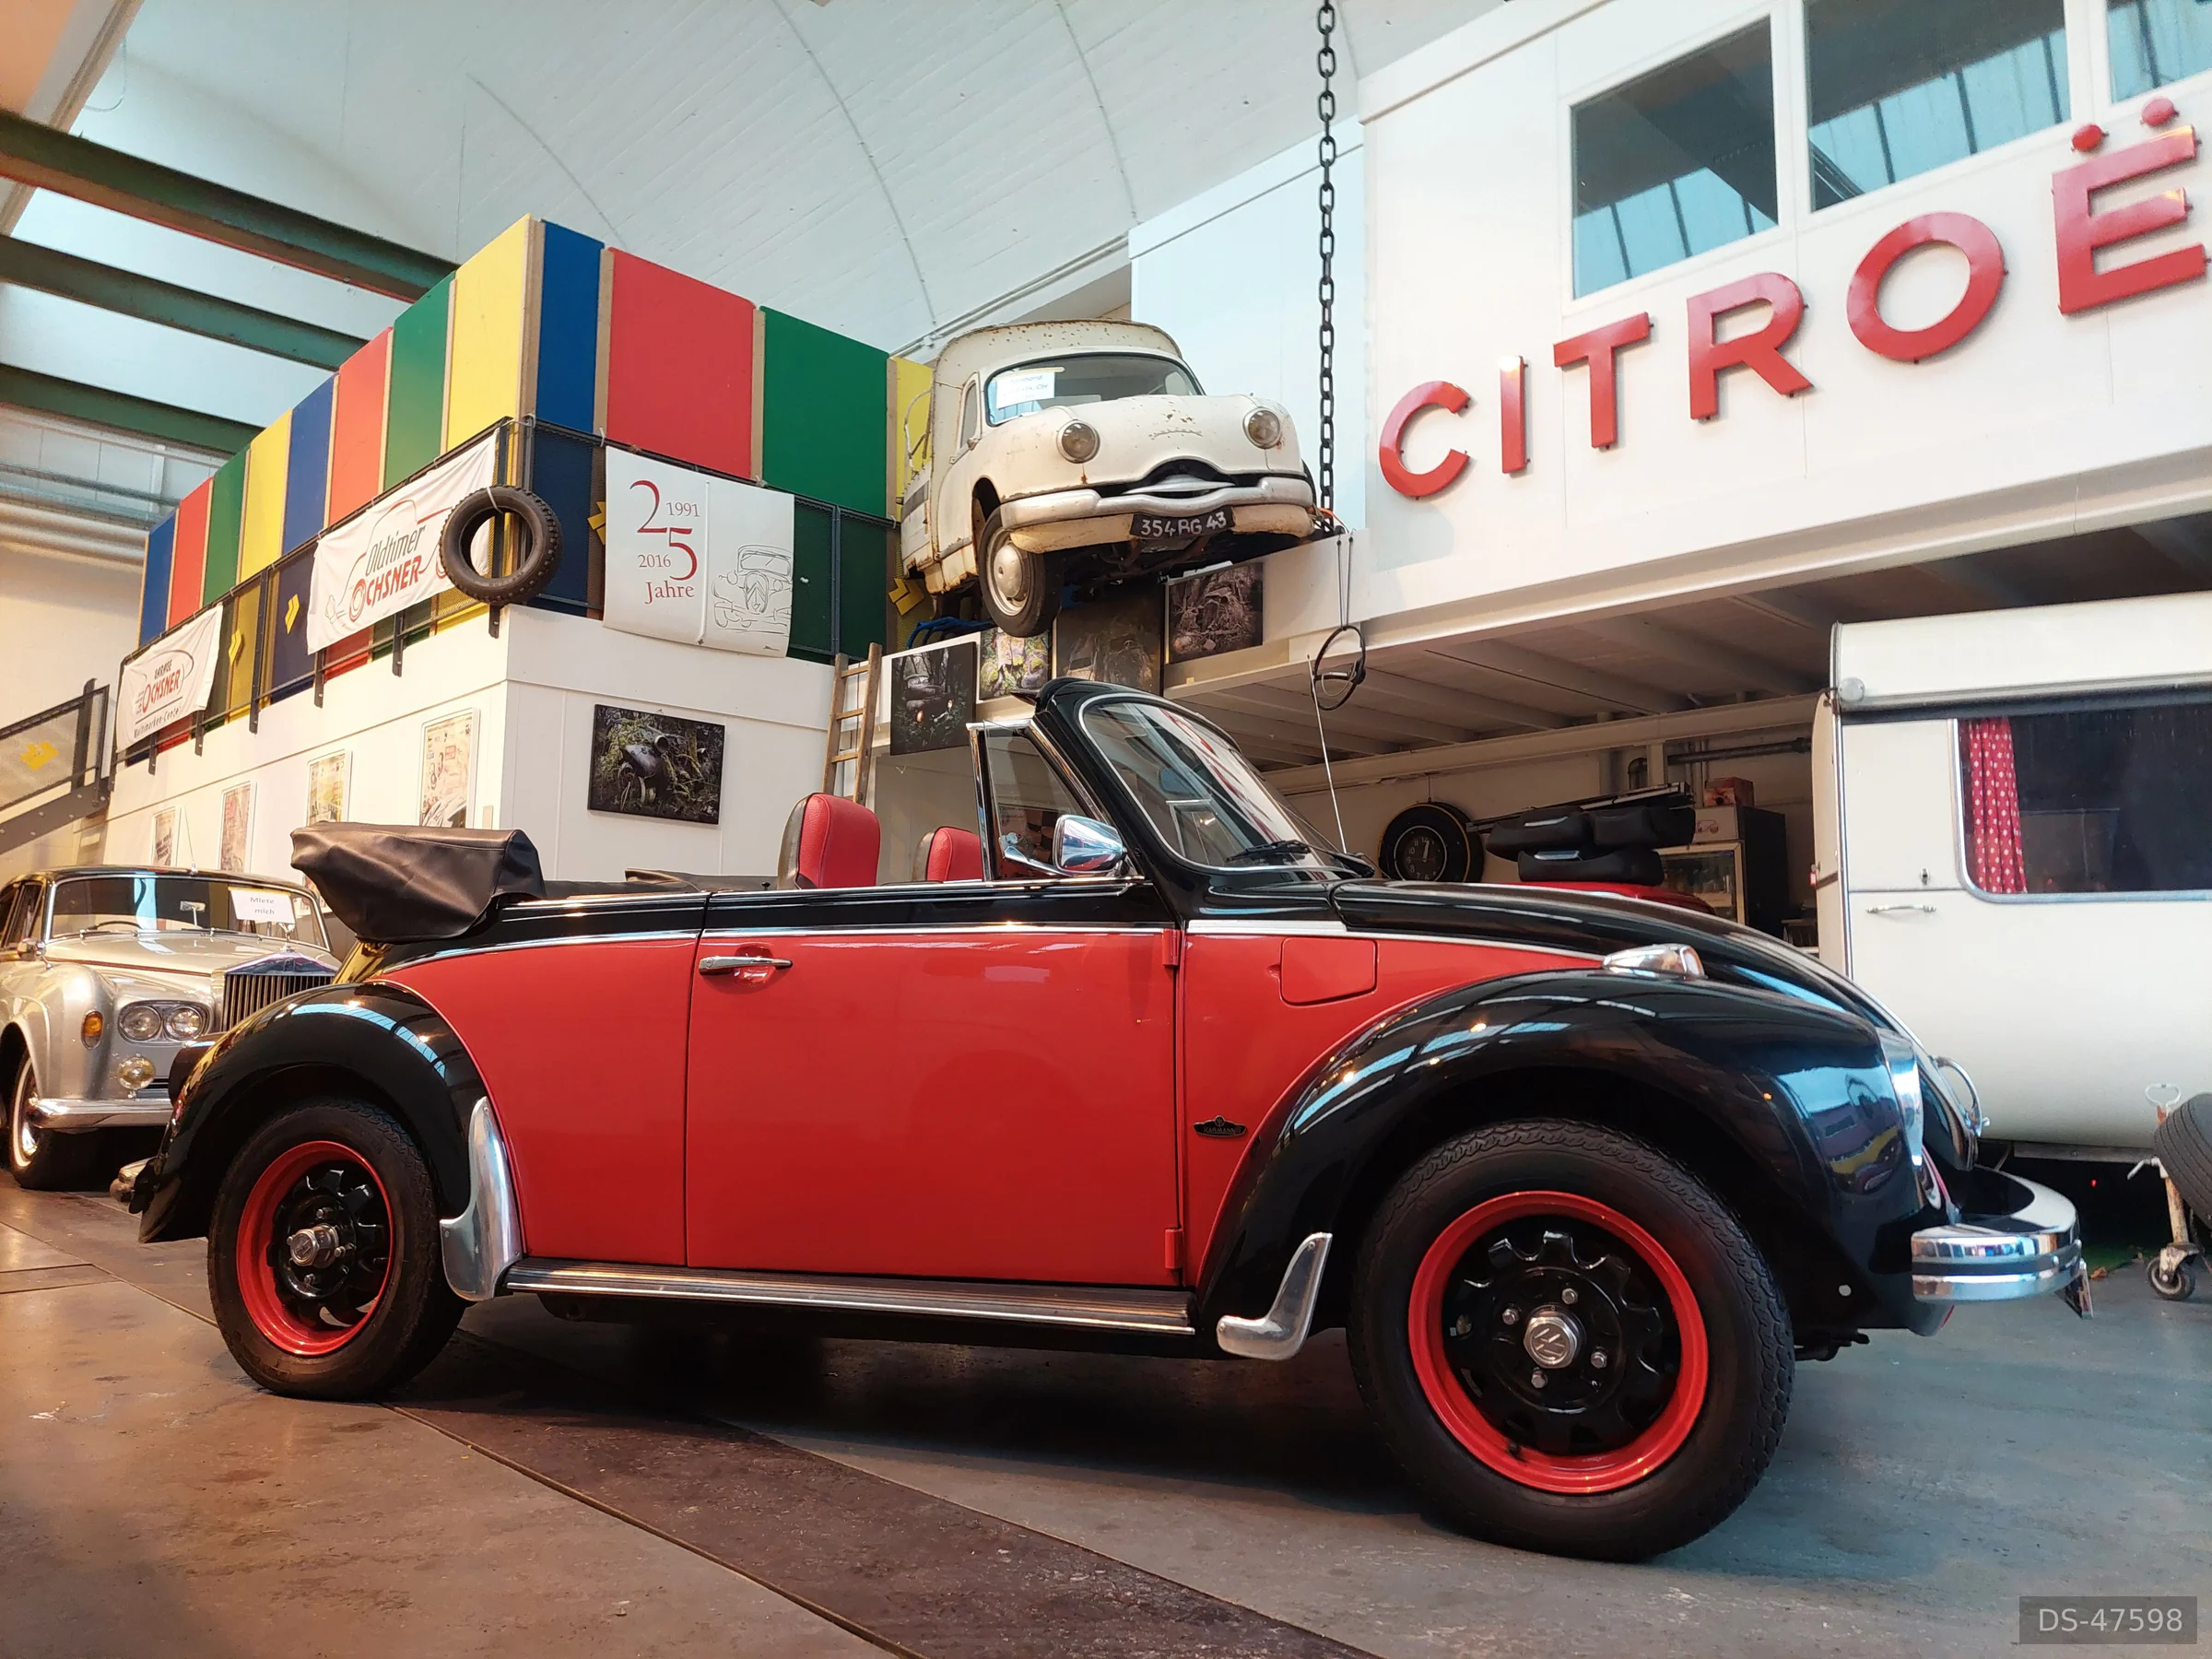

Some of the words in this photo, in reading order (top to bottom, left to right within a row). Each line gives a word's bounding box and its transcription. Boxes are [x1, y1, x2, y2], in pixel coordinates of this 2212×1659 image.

[1379, 97, 2207, 500] CITROË
[665, 501, 700, 518] 1991
[1206, 511, 1228, 530] 43
[365, 525, 427, 578] Oldtimer
[637, 554, 672, 569] 2016
[644, 580, 695, 605] Jahre
[141, 668, 182, 713] OCHSNER
